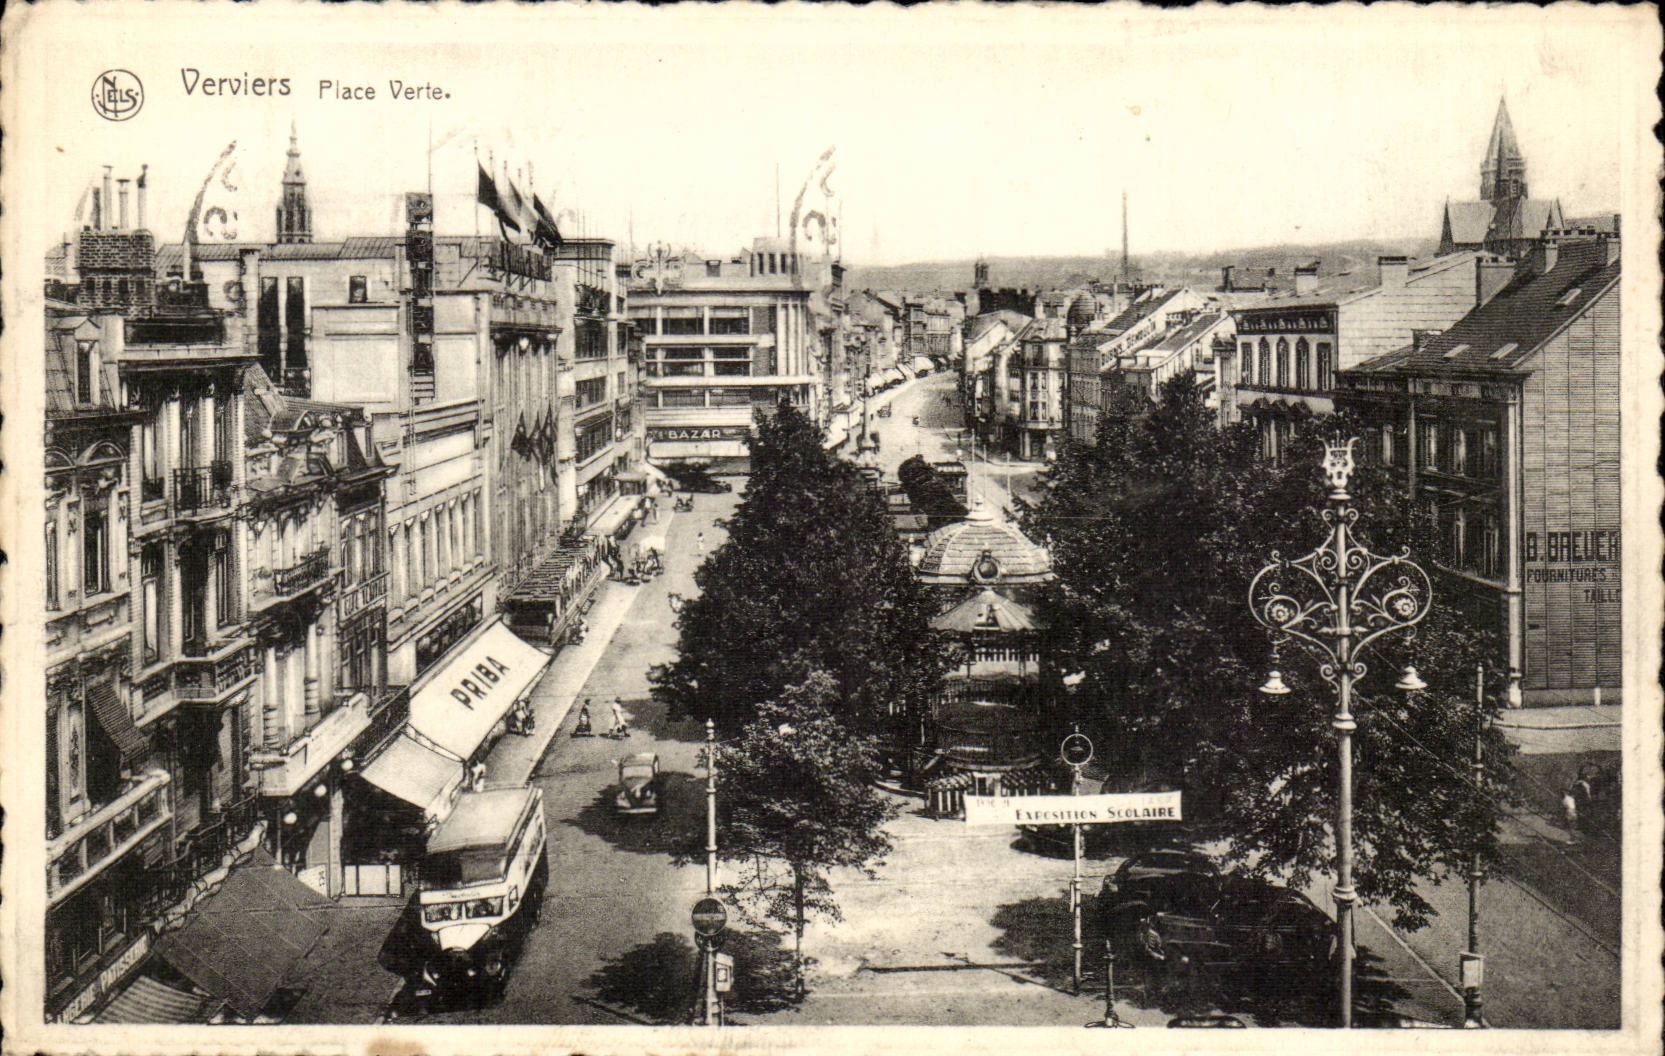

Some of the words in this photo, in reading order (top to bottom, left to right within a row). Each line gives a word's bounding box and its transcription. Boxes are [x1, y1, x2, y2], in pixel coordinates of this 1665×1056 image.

[668, 429, 721, 439] BAZAR
[1547, 531, 1620, 562] BREUER
[1527, 568, 1606, 583] FOURNITURES
[450, 656, 510, 711] PRIBA
[1107, 806, 1175, 819] SCOLAIRE
